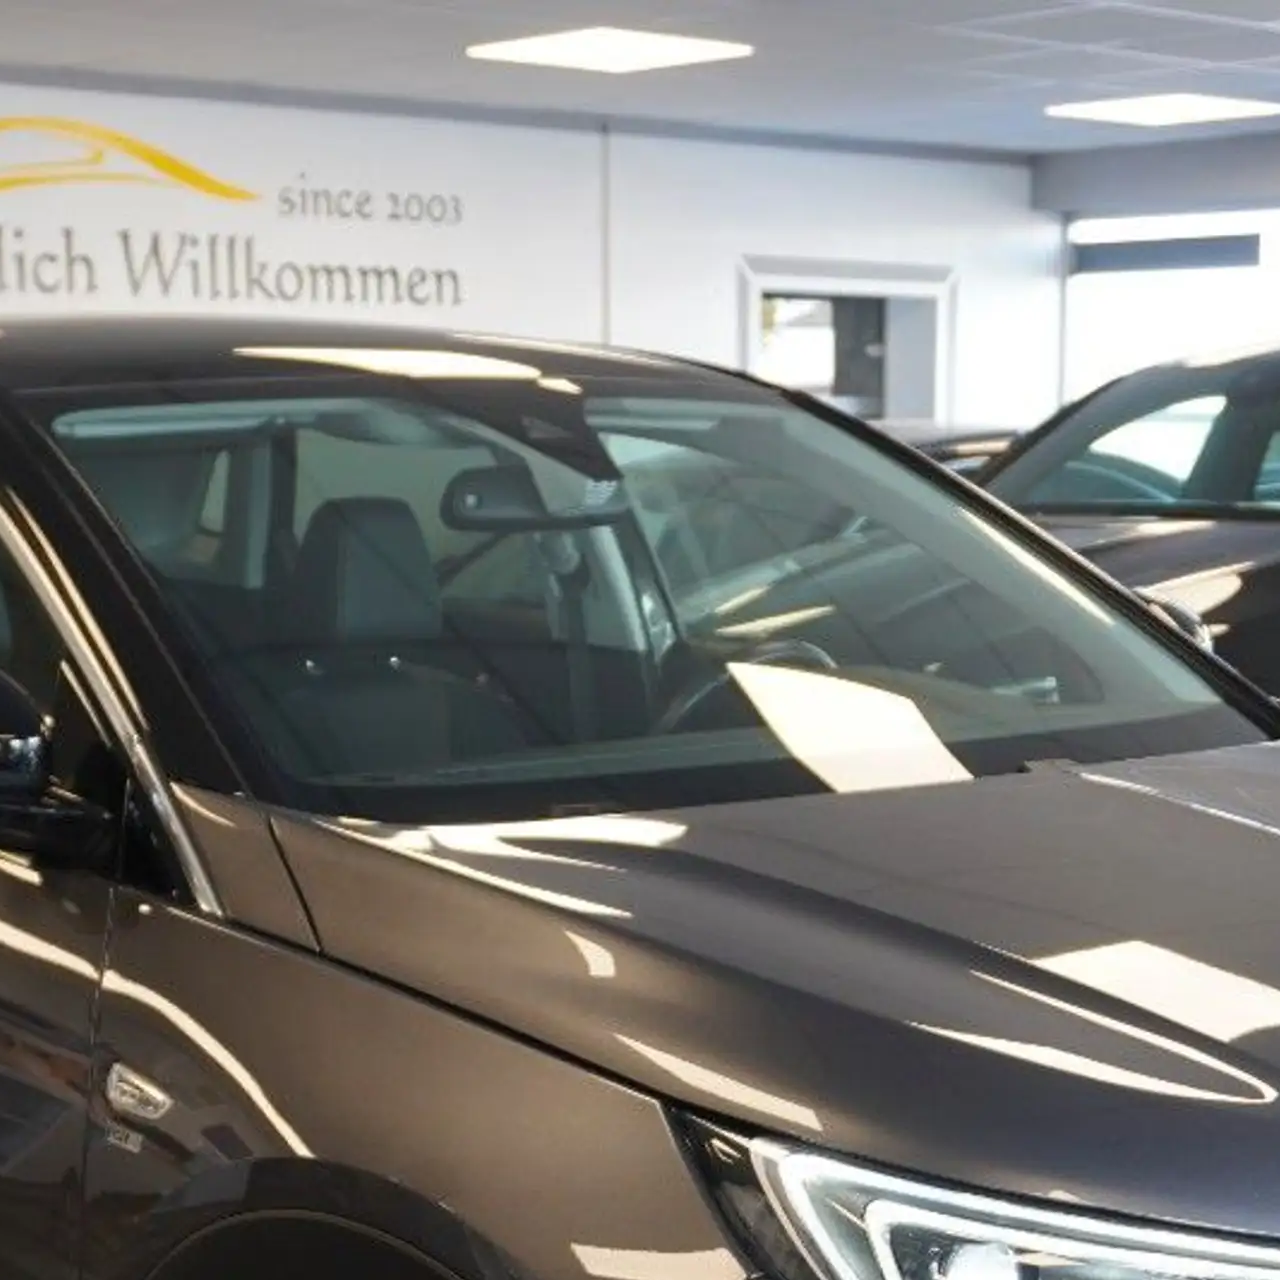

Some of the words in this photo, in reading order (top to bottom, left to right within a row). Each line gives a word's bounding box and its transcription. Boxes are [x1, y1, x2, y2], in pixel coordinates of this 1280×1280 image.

[277, 171, 375, 220] since
[387, 194, 464, 225] 2003
[118, 228, 464, 307] Willkommen
